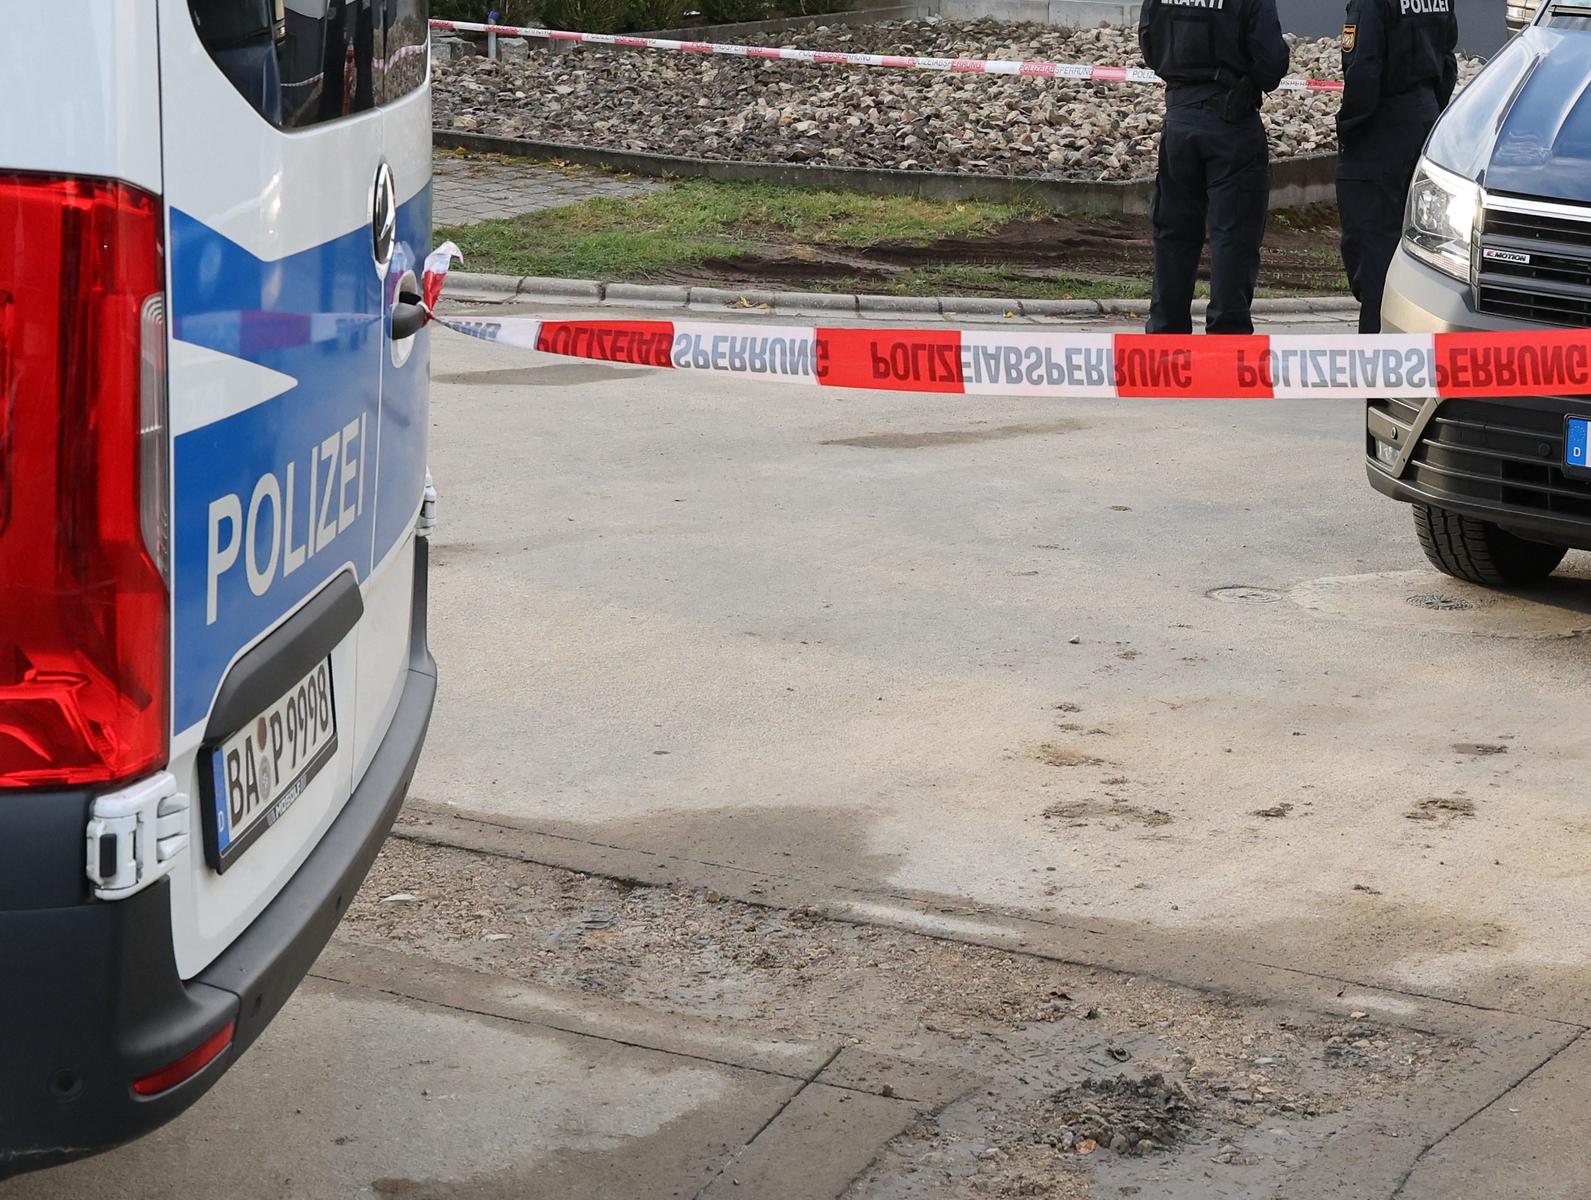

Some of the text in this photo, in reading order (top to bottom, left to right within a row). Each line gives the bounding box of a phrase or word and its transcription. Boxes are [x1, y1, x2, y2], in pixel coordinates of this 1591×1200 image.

[1019, 64, 1094, 76] POLIZEIABSPERRUNG
[1573, 446, 1581, 457] D
[207, 412, 366, 625] POLIZEI
[227, 736, 259, 828] BA
[218, 811, 224, 833] D
